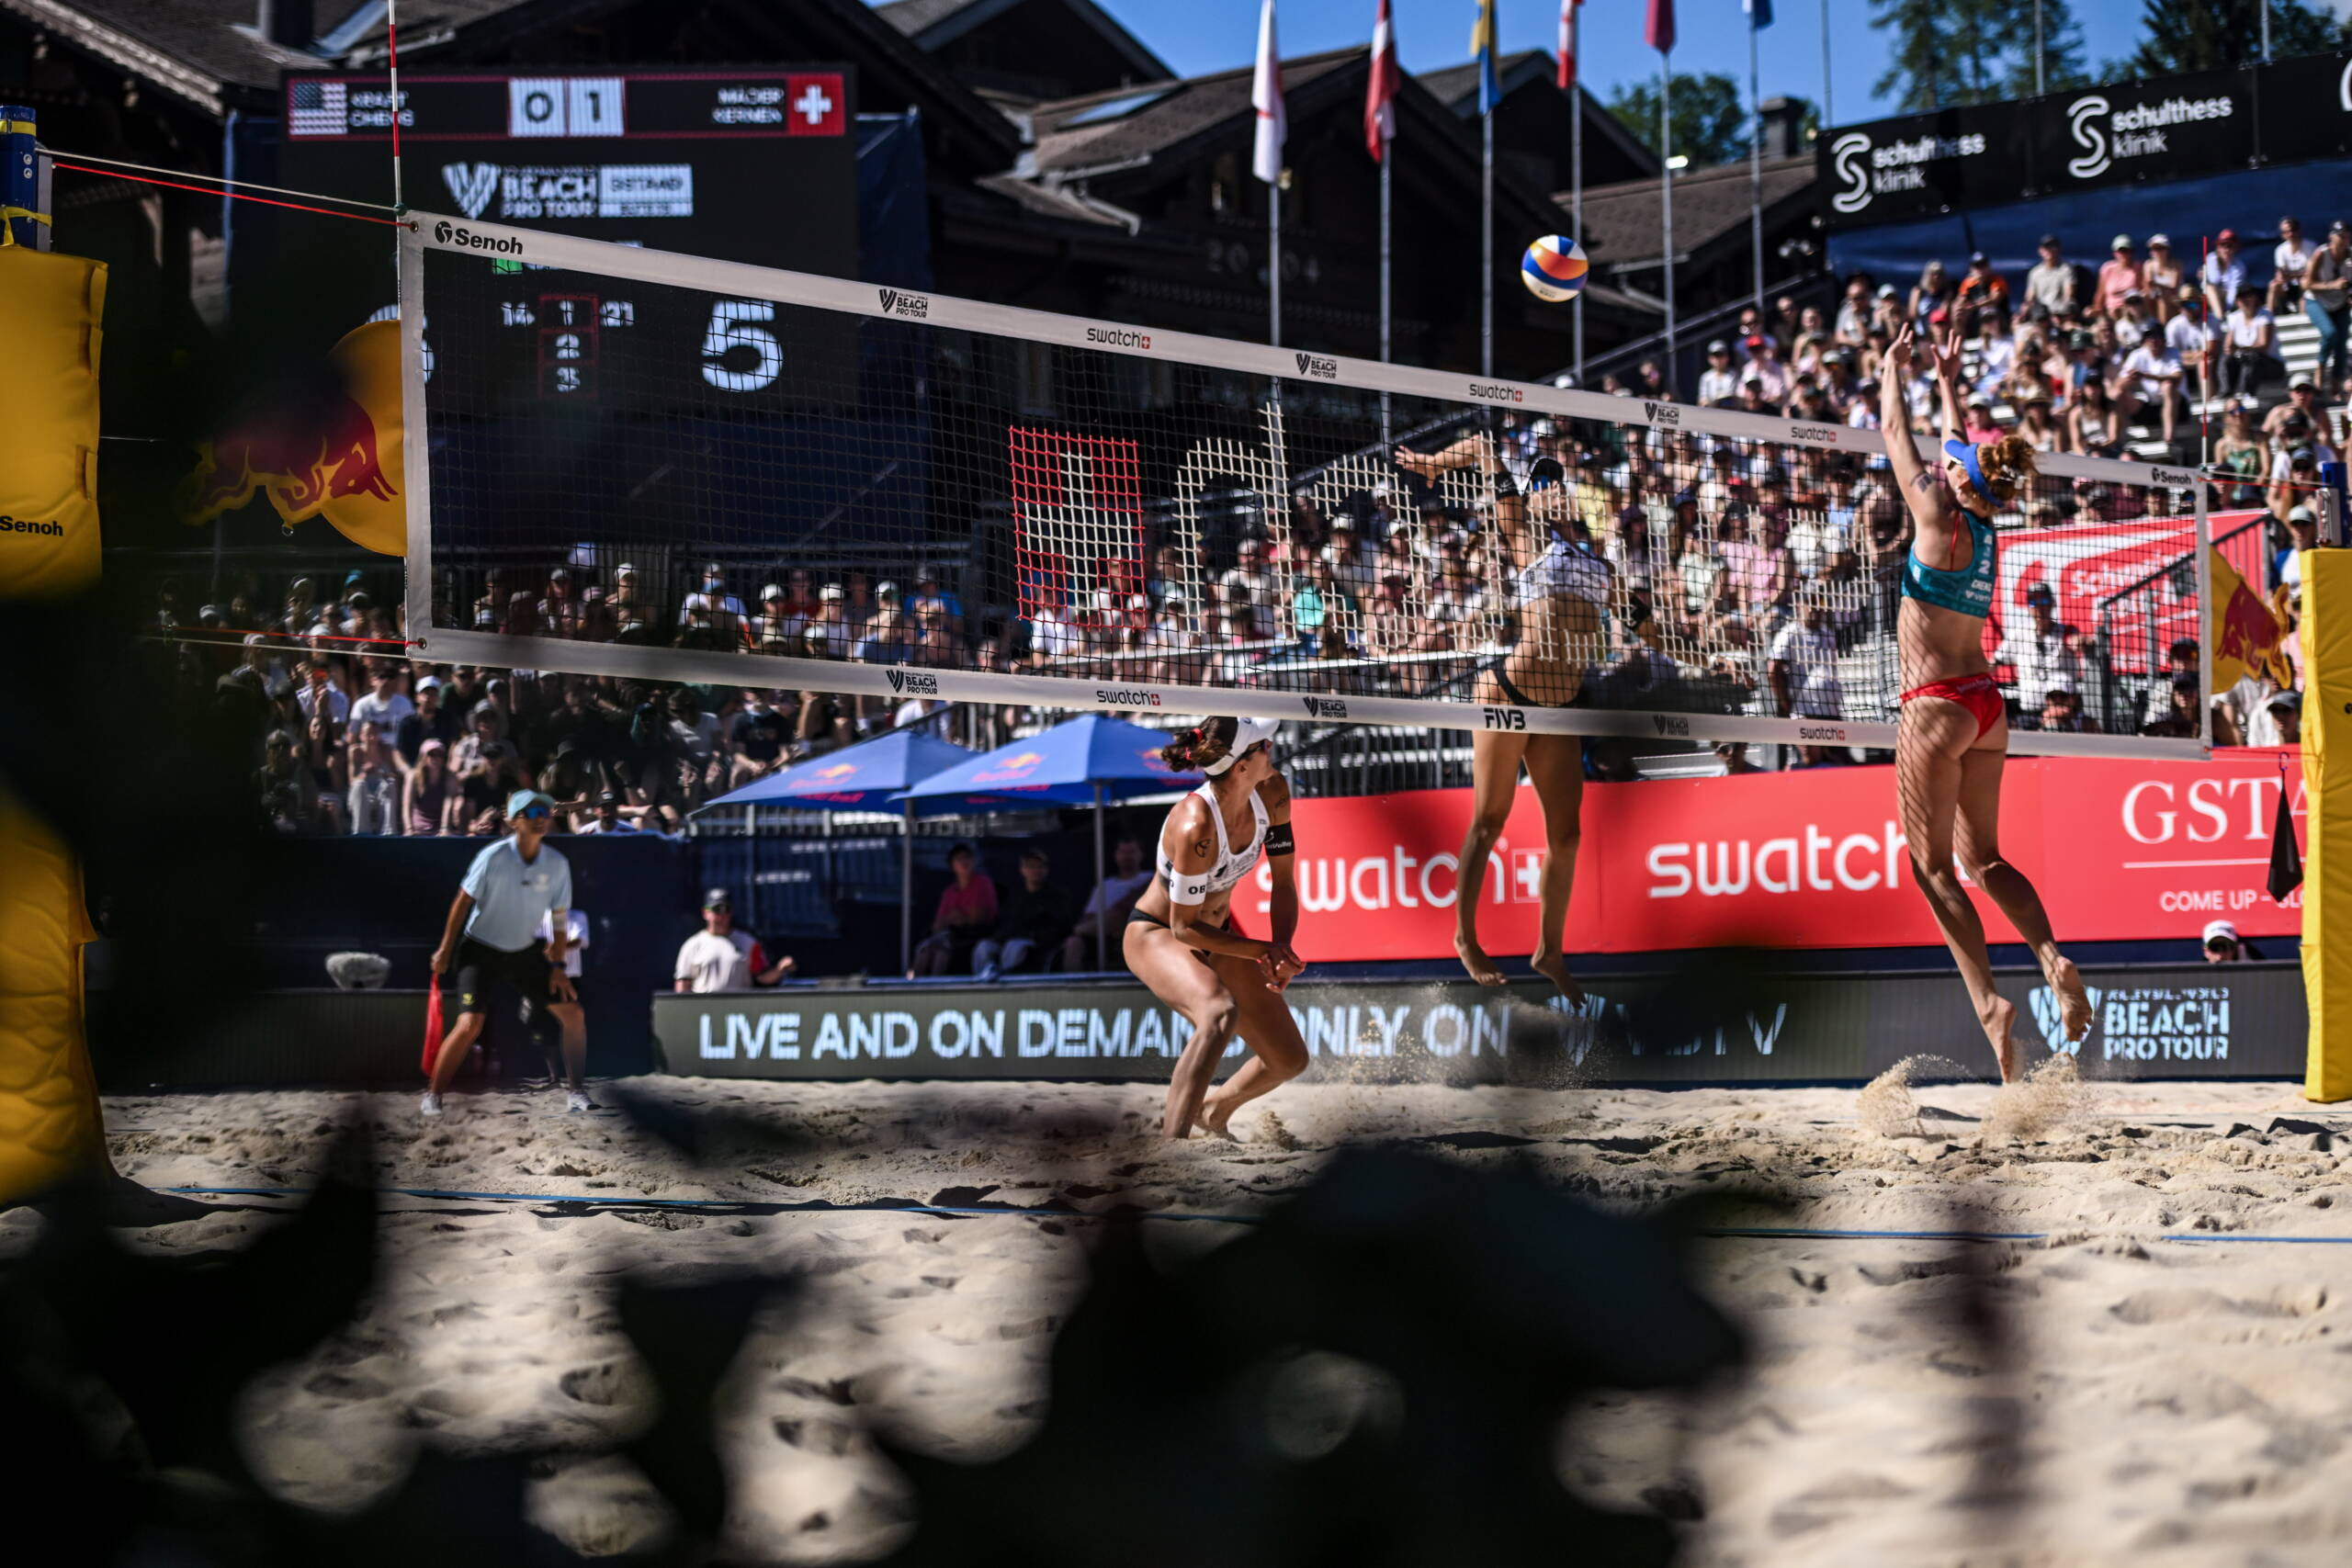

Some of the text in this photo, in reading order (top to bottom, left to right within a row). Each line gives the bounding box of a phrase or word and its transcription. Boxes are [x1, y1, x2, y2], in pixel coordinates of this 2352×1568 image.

[526, 93, 552, 122] 0
[585, 93, 602, 122] 1
[2111, 96, 2233, 131] schulthess
[1872, 133, 1984, 168] schulthess
[2112, 130, 2167, 158] klinik
[501, 175, 597, 200] BEACH
[1872, 165, 1926, 193] klinik
[454, 228, 524, 254] Senoh
[896, 308, 927, 319] PRO TOUR
[897, 297, 928, 310] BEACH
[702, 301, 783, 391] 5
[1087, 327, 1141, 348] swatch
[1311, 360, 1337, 372] BEACH
[1469, 384, 1514, 401] swatch
[1792, 426, 1829, 442] swatch
[2161, 473, 2192, 485] Senoh
[0, 515, 63, 536] Senoh
[905, 675, 937, 688] BEACH
[907, 686, 938, 695] PRO TOUR
[1096, 689, 1150, 706] swatch
[1319, 702, 1347, 714] BEACH
[1483, 707, 1526, 730] FIVB
[1800, 727, 1838, 740] swatch
[2160, 890, 2223, 912] COME
[2229, 889, 2257, 909] UP
[2103, 1000, 2231, 1036] BEACH
[699, 1012, 800, 1060] LIVE
[811, 1011, 920, 1060] AND
[928, 1009, 1006, 1058] ON
[1422, 1003, 1510, 1057] ON
[2103, 1036, 2230, 1061] PRO TOUR
